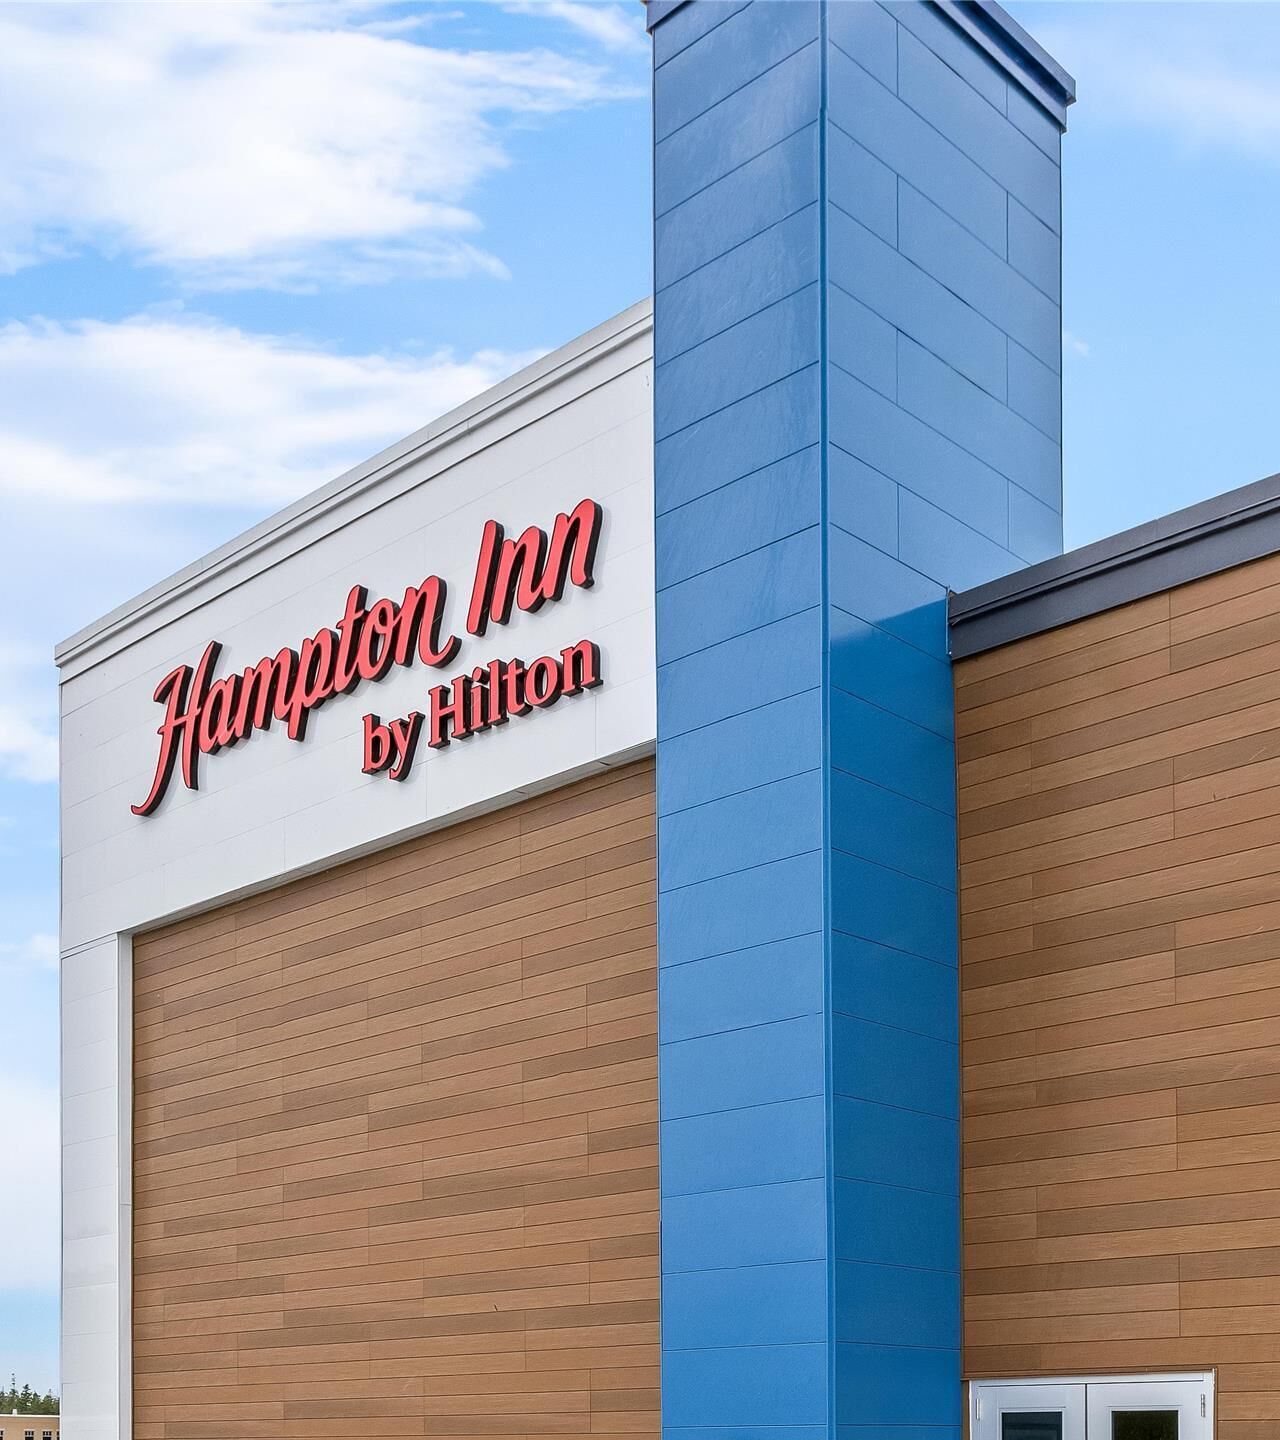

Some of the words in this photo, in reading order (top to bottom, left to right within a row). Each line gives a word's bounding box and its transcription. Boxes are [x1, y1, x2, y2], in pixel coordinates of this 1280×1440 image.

[130, 574, 462, 817] Hampton
[466, 497, 603, 637] Inn
[361, 710, 426, 782] by
[427, 639, 603, 749] Hilton
